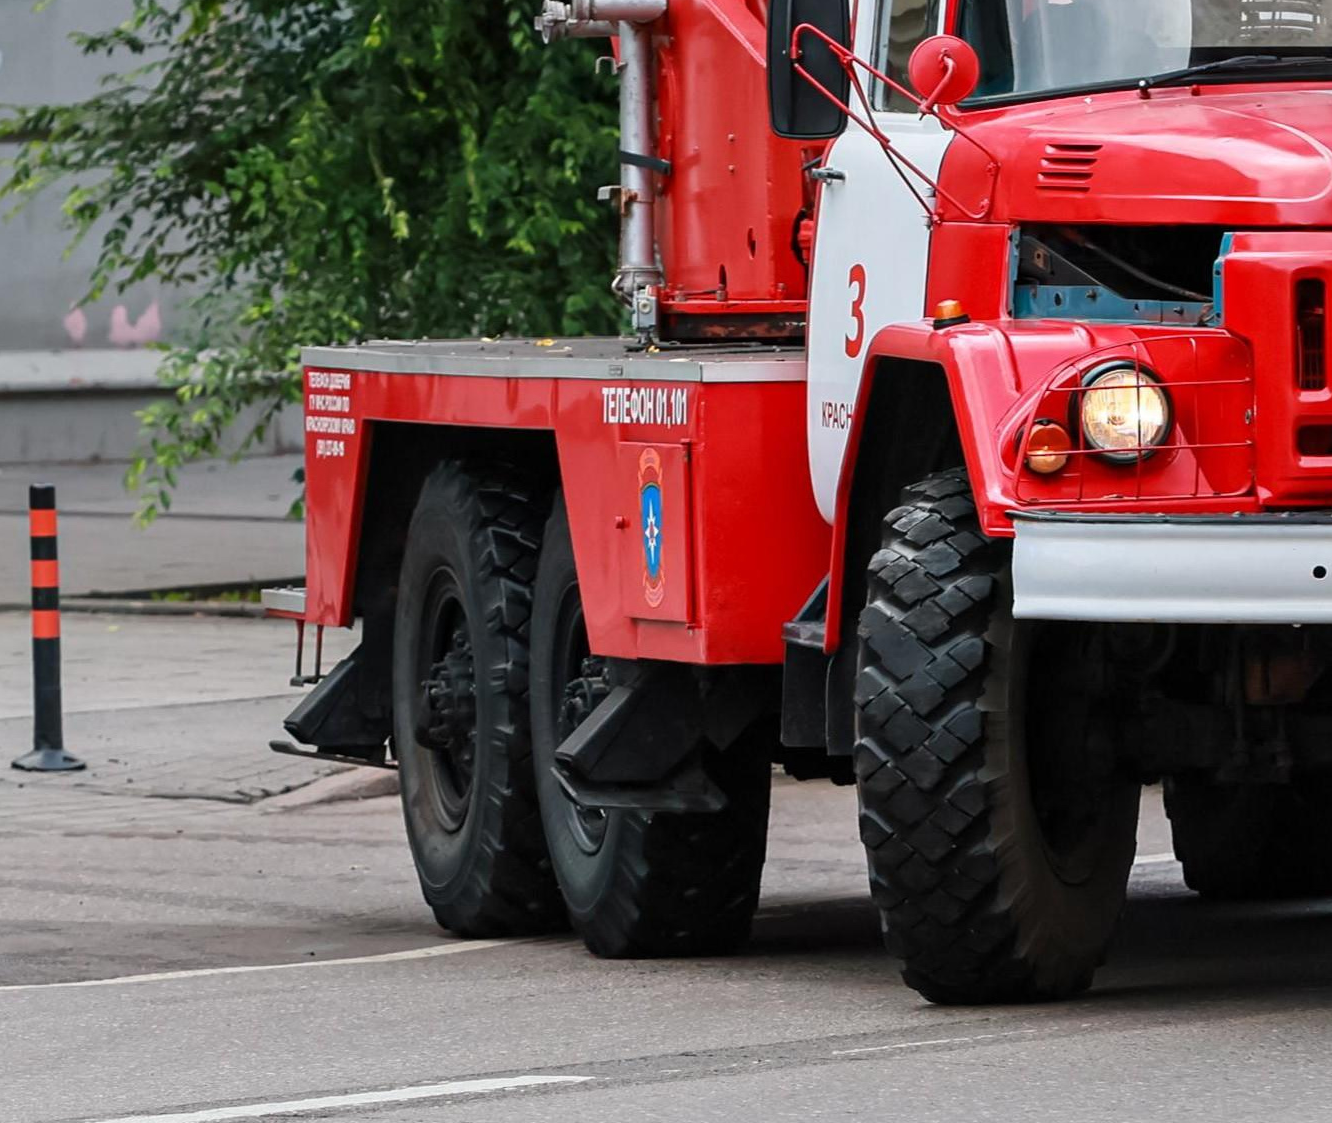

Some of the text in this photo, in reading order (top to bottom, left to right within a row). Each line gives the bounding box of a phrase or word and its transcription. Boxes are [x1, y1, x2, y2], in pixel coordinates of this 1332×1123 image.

[844, 262, 866, 359] 3
[602, 387, 687, 429] ТЕЛЕФОН 01,101
